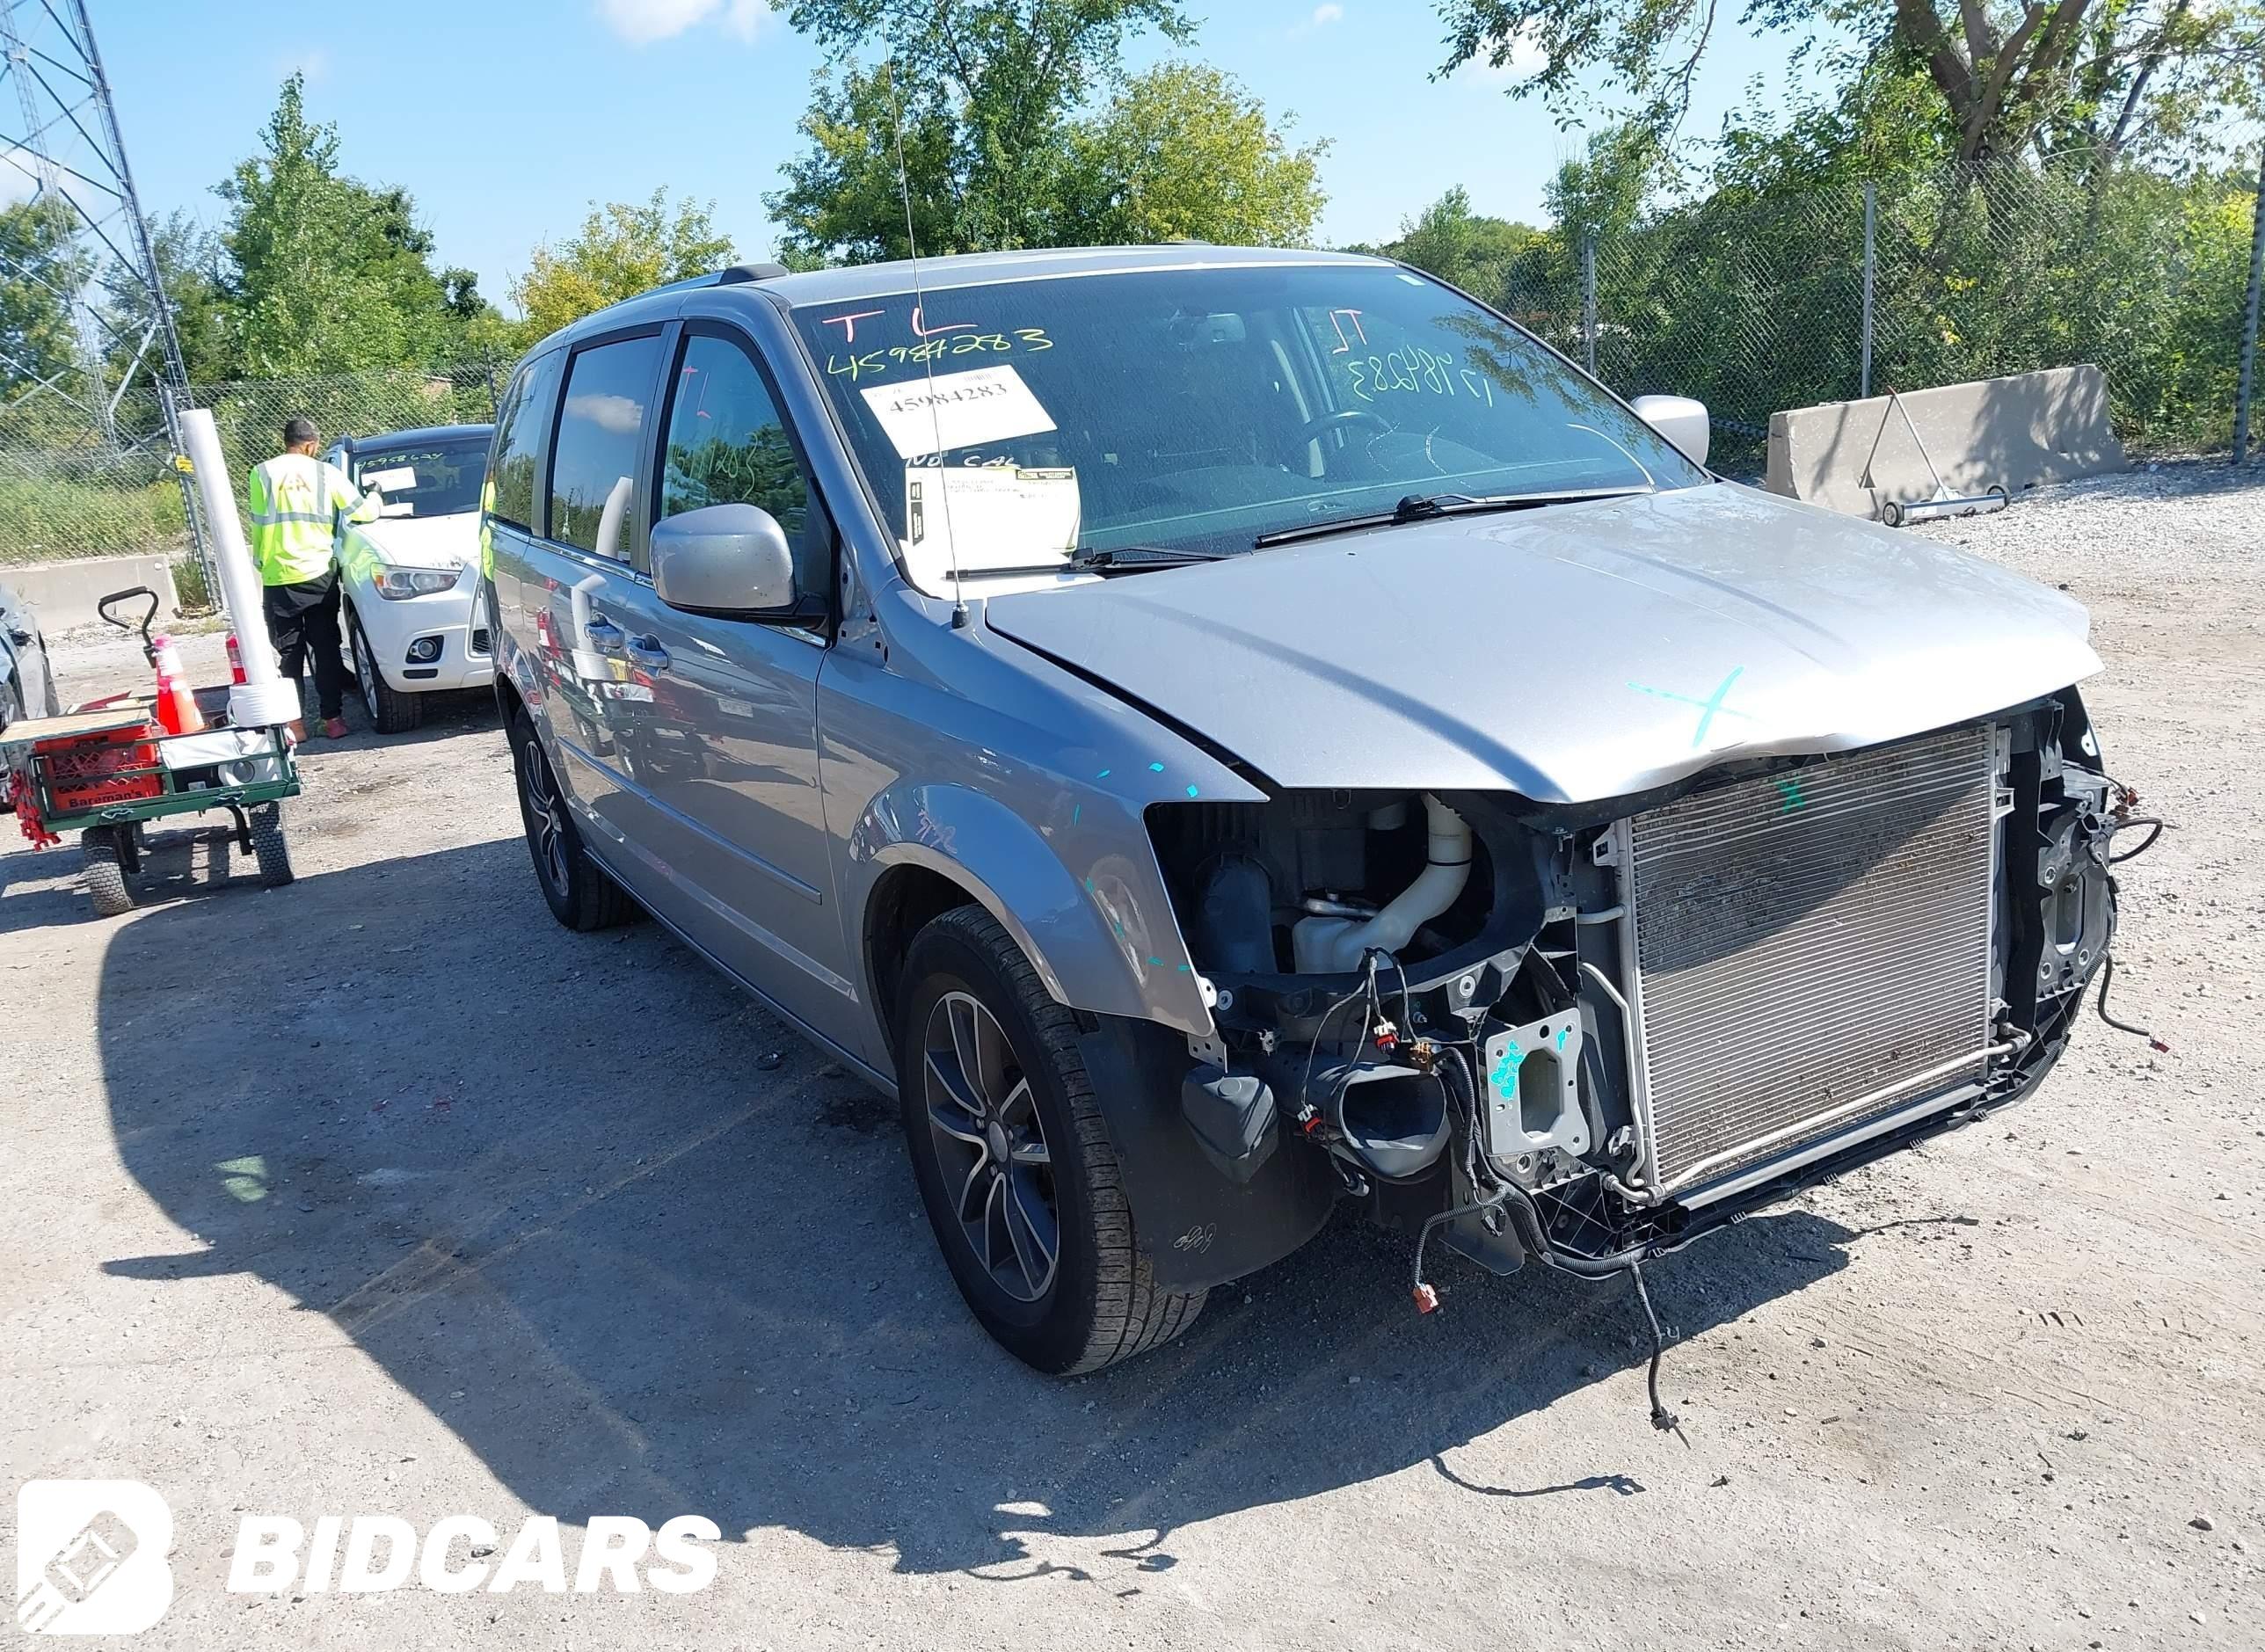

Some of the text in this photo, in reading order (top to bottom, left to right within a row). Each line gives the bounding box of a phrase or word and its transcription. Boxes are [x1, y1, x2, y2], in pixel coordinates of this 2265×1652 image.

[827, 328, 1054, 382] 45984283
[890, 383, 1007, 412] 45984283
[69, 789, 143, 808] Bareman's
